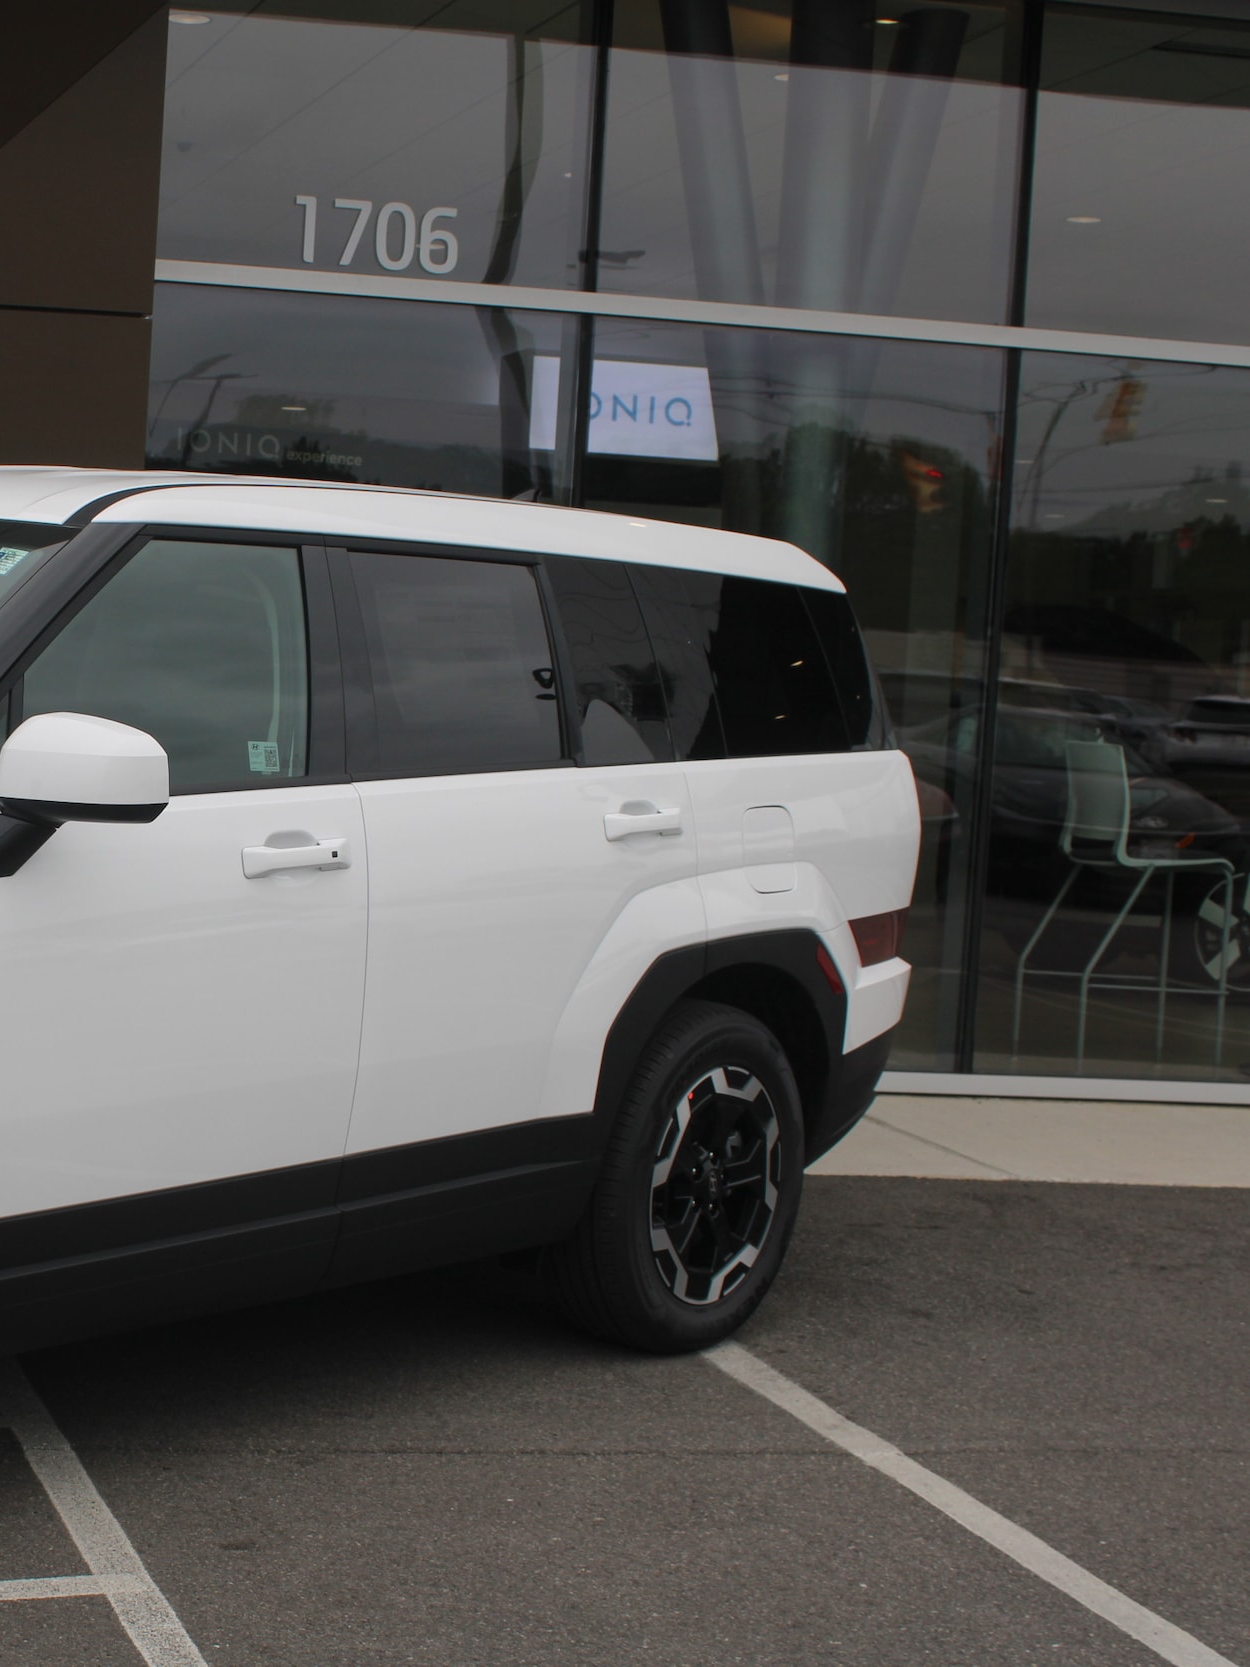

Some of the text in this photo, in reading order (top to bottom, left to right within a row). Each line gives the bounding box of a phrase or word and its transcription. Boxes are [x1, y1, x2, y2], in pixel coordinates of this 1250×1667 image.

[295, 195, 459, 275] 1706
[177, 426, 364, 467] IONIQ experience
